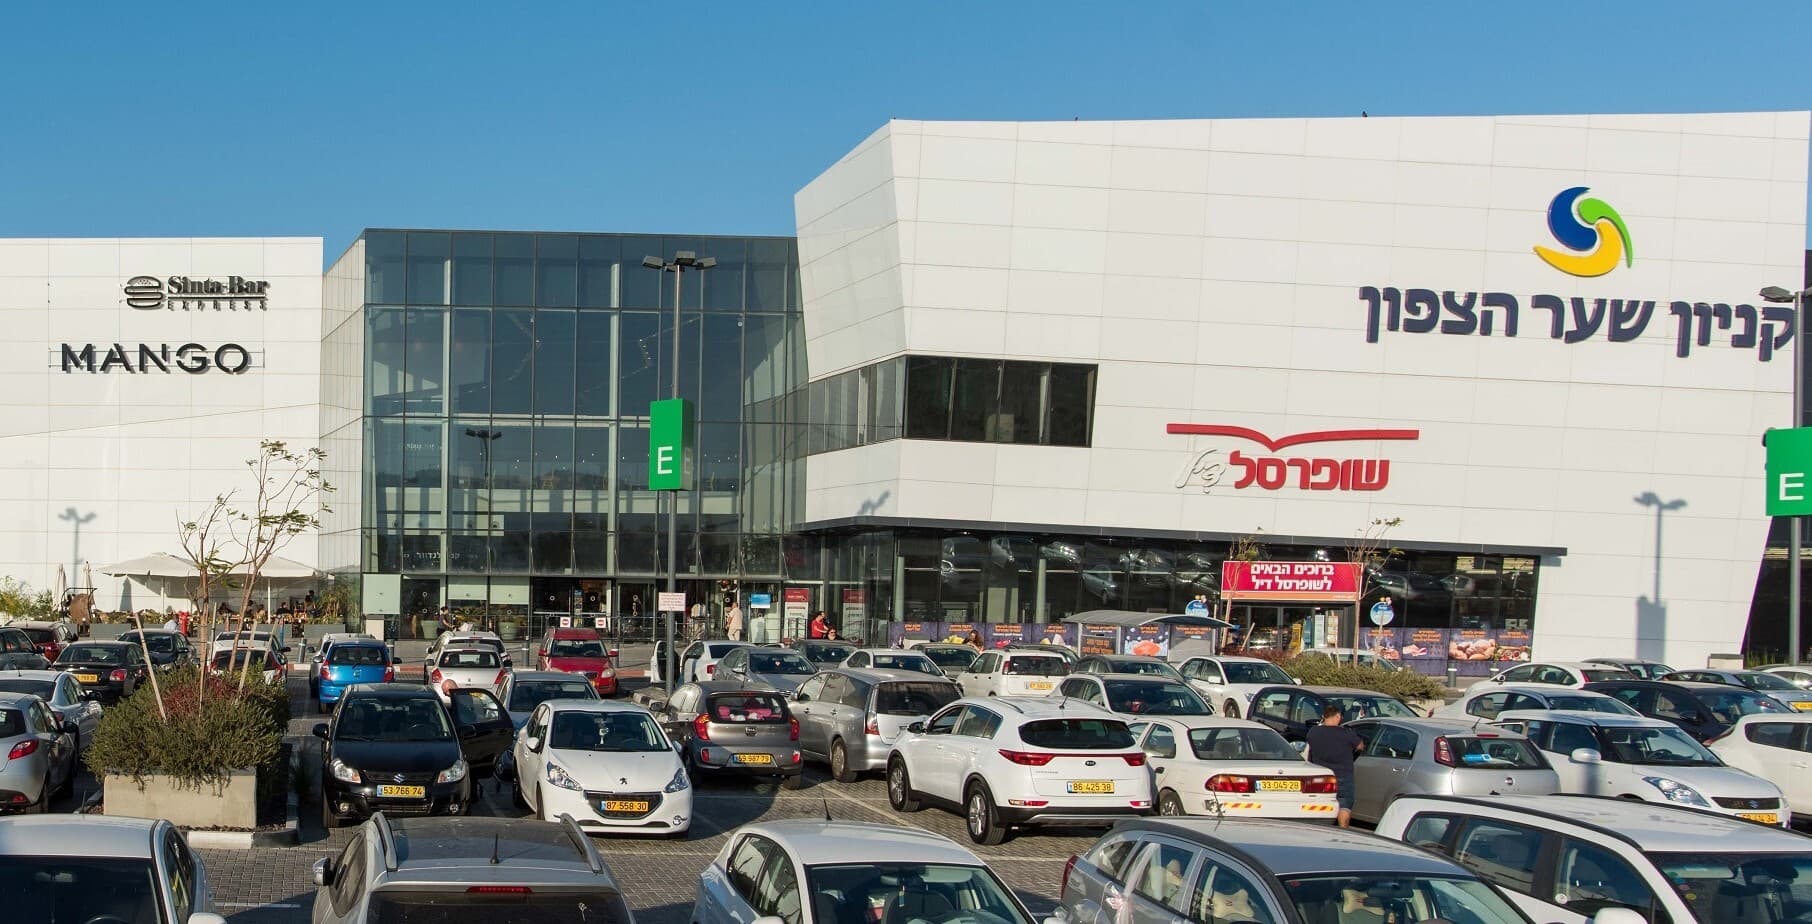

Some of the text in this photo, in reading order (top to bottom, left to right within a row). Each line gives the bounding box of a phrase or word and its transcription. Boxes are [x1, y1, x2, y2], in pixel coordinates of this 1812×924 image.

[167, 276, 268, 294] Sinta-Bar
[167, 301, 267, 310] EXPRESS
[1358, 286, 1796, 362] קניון שער הצפון
[61, 343, 249, 374] MANGO
[657, 446, 673, 475] E
[1229, 450, 1390, 491] שופרסל
[1779, 473, 1804, 501] E
[1250, 563, 1335, 576] ברוכים הבאים
[1251, 575, 1333, 591] לשופרסל דיל
